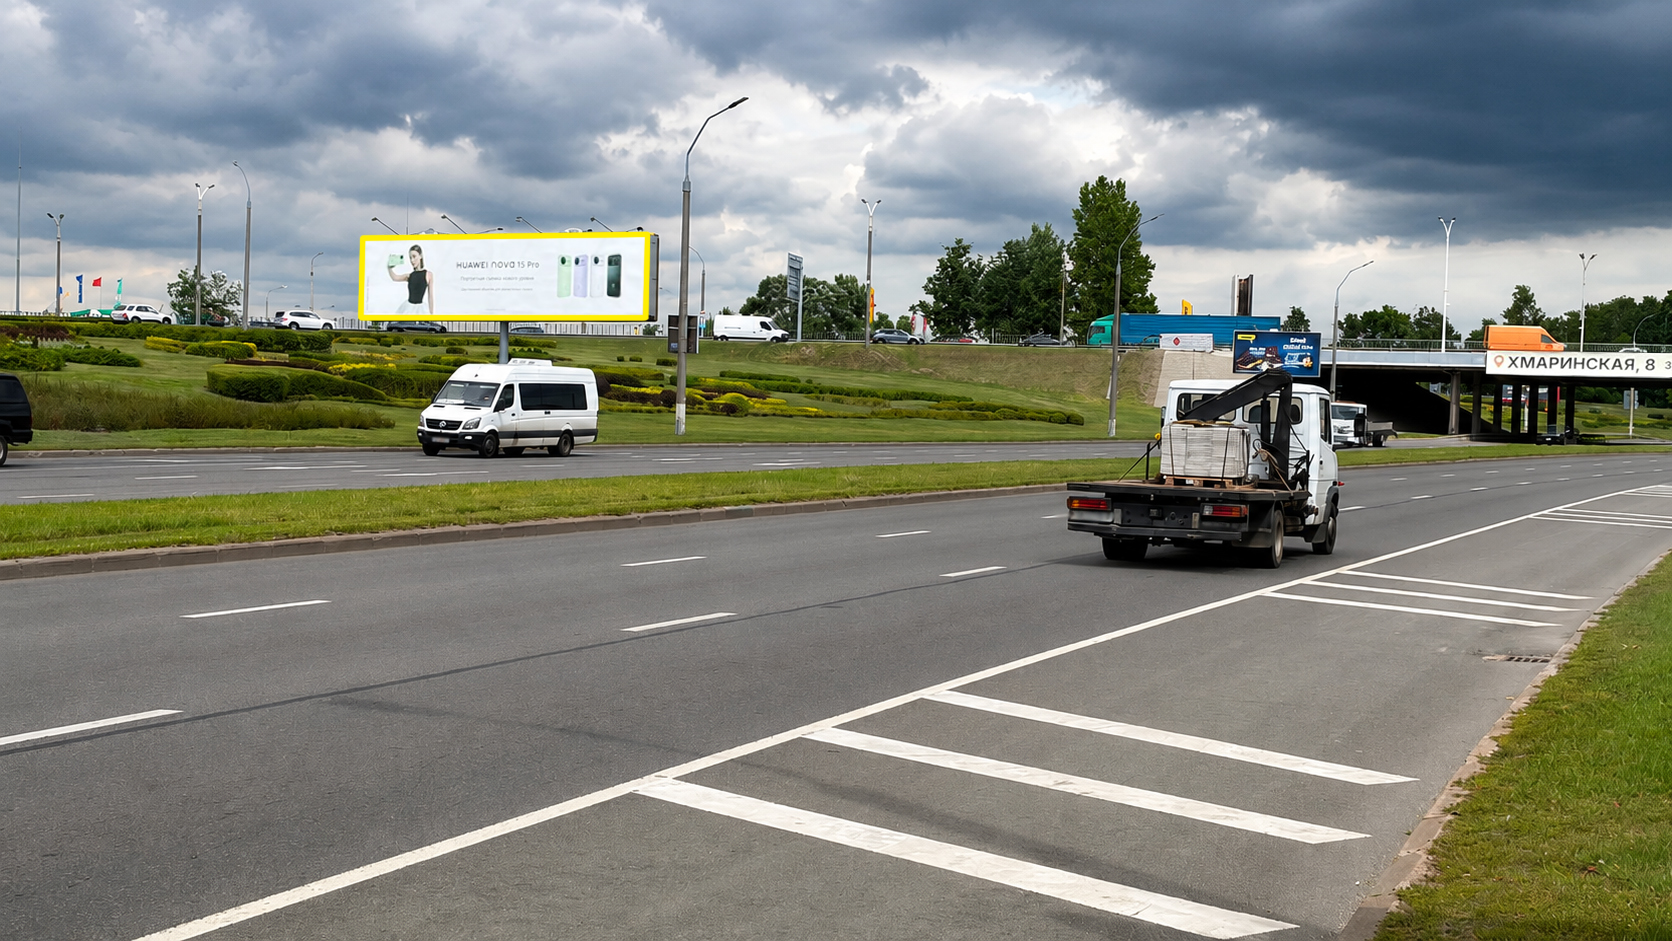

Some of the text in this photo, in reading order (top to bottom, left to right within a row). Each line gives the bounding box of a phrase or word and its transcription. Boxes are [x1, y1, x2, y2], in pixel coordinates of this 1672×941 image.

[456, 261, 540, 269] HUAWEI nova 15 Pro
[1507, 356, 1640, 373] ХМАРИНСКАЯ,
[1645, 358, 1655, 371] 8
